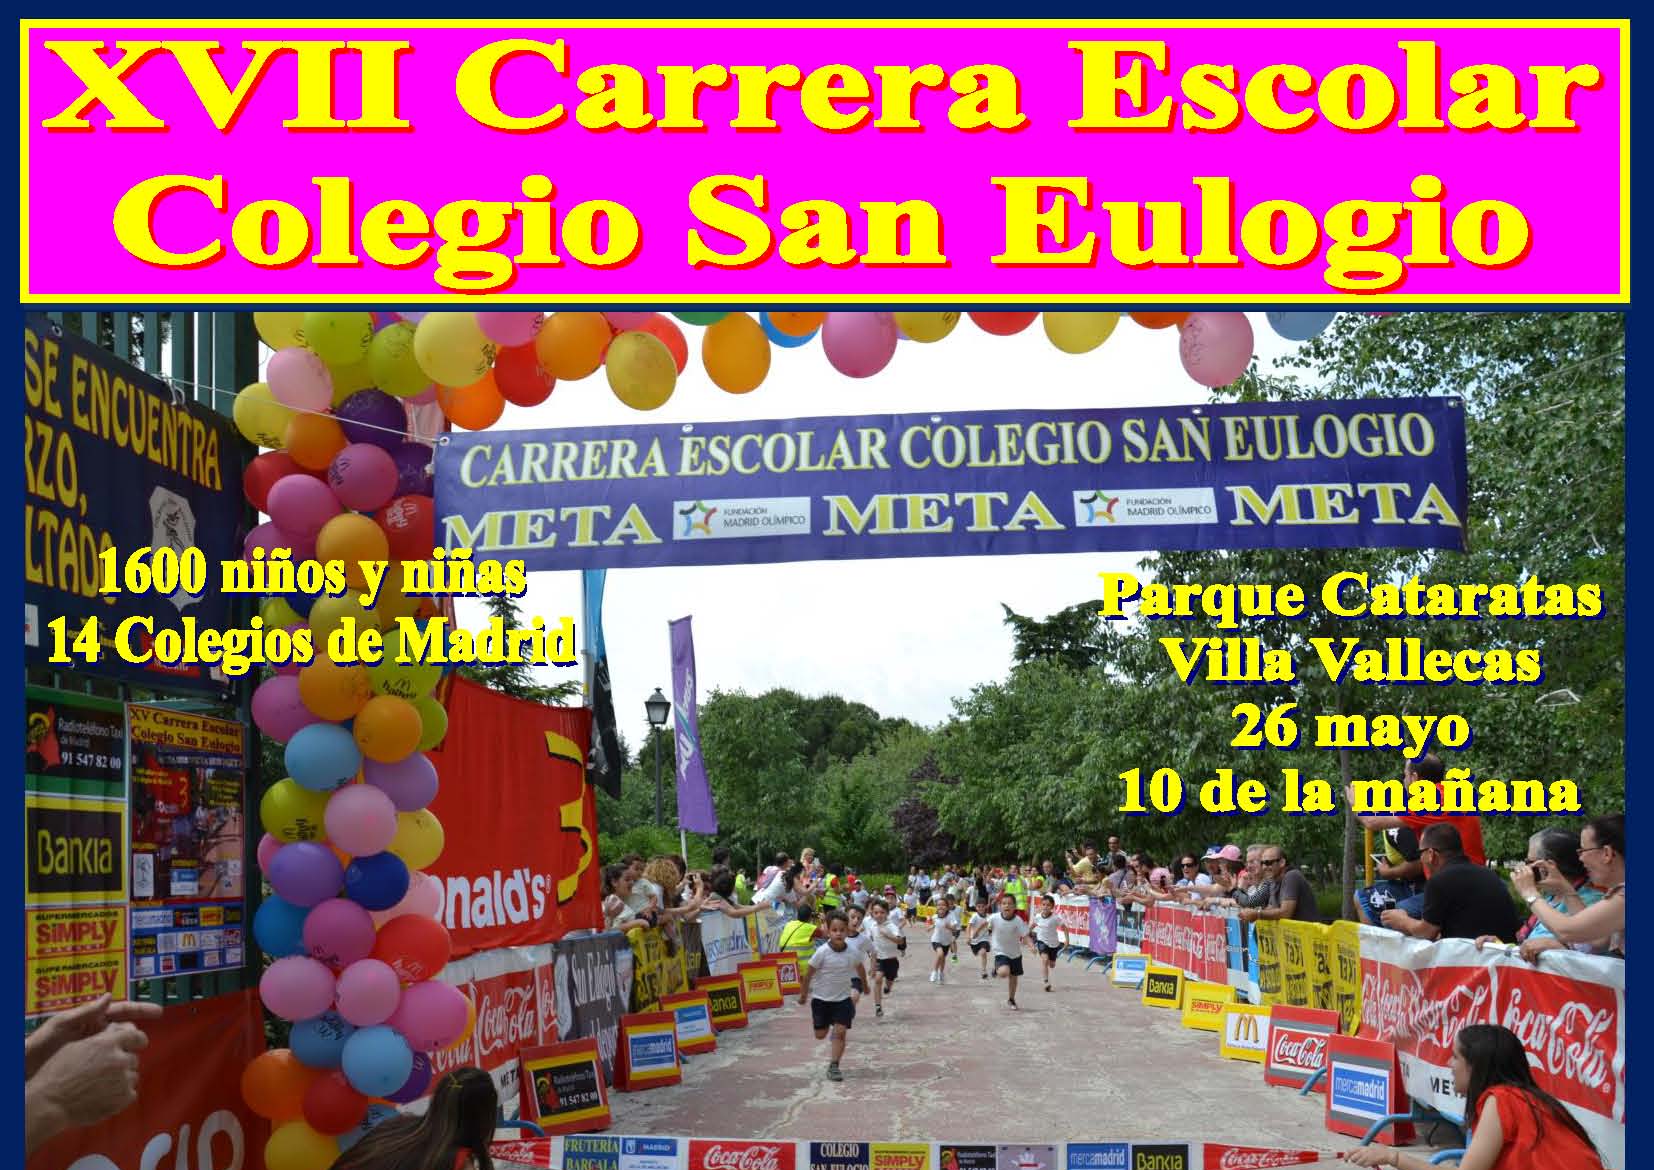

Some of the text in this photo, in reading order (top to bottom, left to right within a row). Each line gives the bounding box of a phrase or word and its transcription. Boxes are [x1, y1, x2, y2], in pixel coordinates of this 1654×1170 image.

[43, 40, 1598, 128] XVII Carrera Escolar
[114, 176, 1528, 289] Colegio San Eulogio
[25, 328, 222, 491] SE ENCUENTRA
[461, 412, 1435, 488] CARRERA ESCOLAR COLEGIO SAN EULOGIO
[723, 513, 806, 528] MADRID OLÍMPICO
[823, 492, 1067, 536] META
[1127, 504, 1212, 517] MADRID OLÍMPICO
[1226, 482, 1464, 528] META
[441, 503, 663, 554] META
[130, 727, 242, 754] Colegio San Eulogio
[152, 711, 199, 732] Carrera
[201, 719, 241, 736] Escolar
[61, 752, 122, 769] 91 547 82 00
[37, 829, 113, 876] Bankia
[571, 951, 589, 1008] San
[1149, 979, 1175, 995] Bankia
[1275, 1033, 1328, 1069] Coca-Cola
[1335, 1075, 1385, 1101] mercamadrid
[820, 1142, 860, 1158] COLEGIO
[1070, 1149, 1126, 1168] mercamadrid
